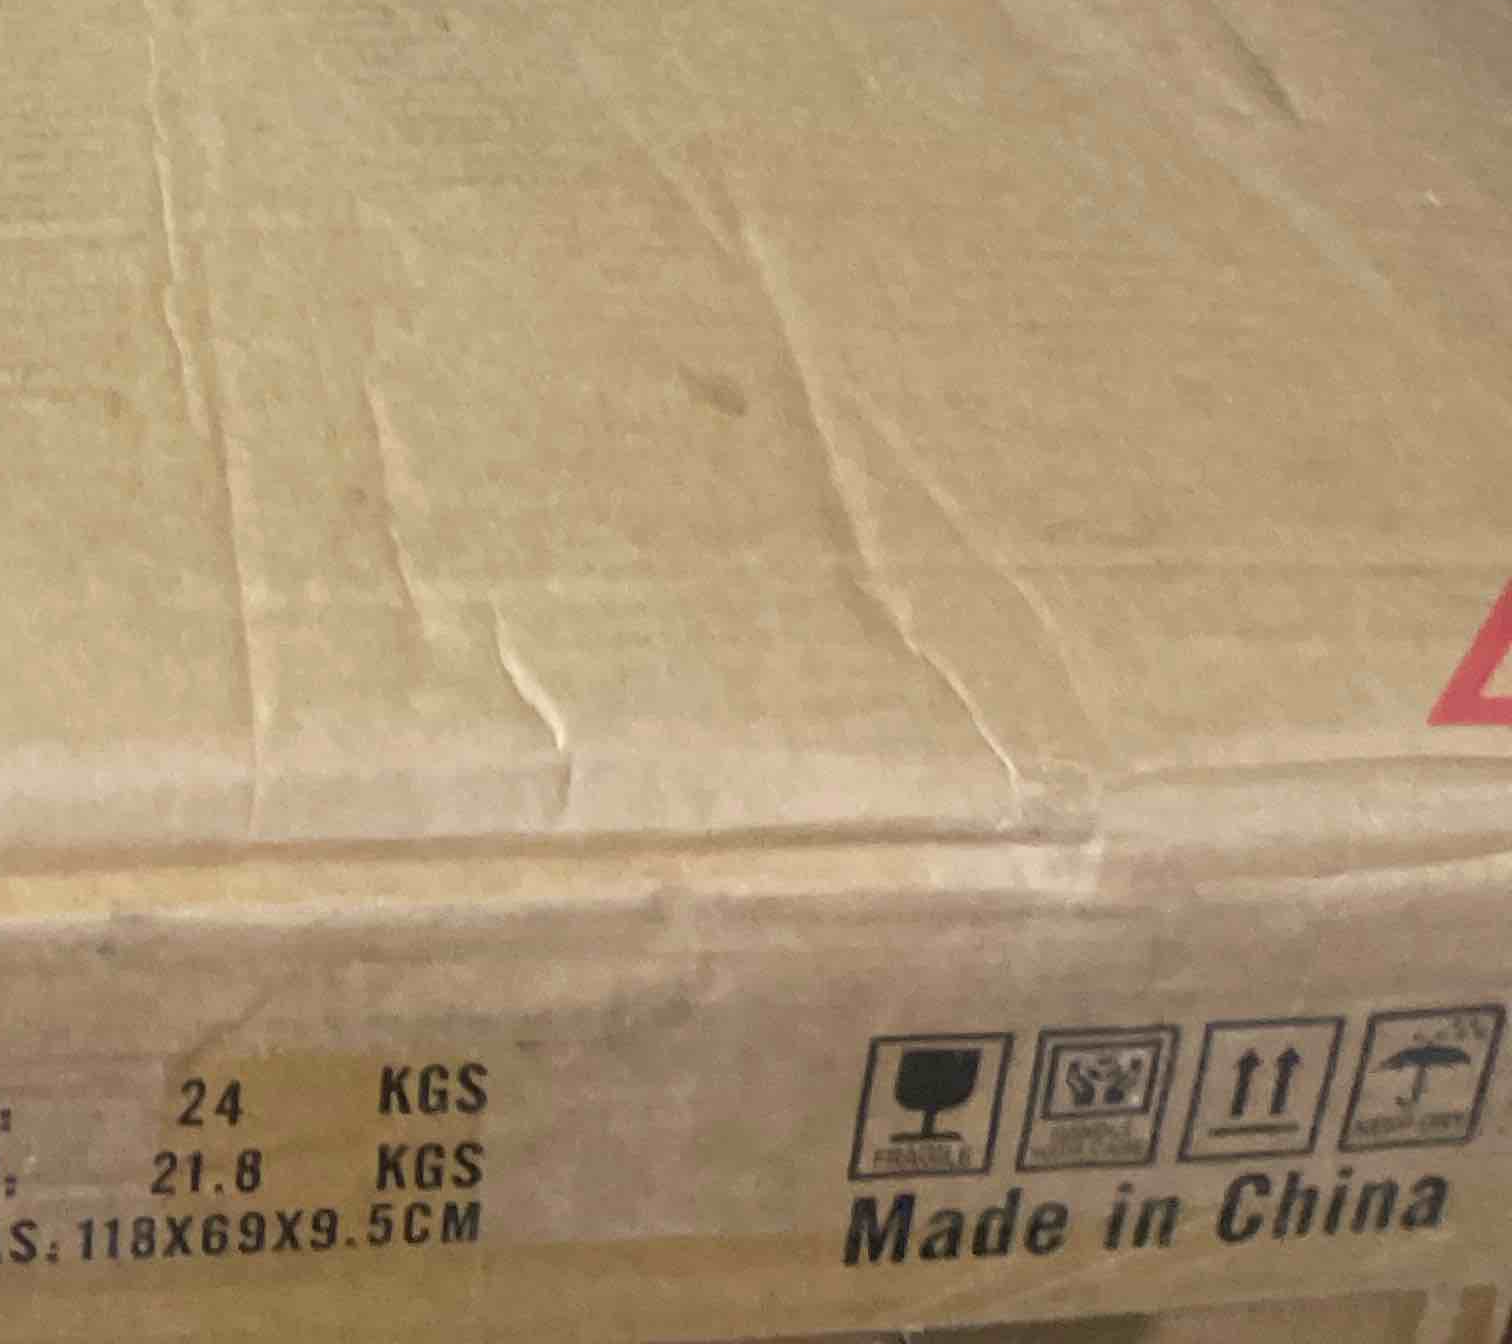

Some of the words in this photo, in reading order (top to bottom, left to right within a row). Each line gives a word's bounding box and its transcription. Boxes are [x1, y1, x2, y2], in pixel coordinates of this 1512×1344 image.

[178, 1078, 244, 1127] 24
[378, 1062, 489, 1116] KGS
[150, 1149, 263, 1196] 21.8
[376, 1142, 485, 1191] KGS
[843, 1187, 1069, 1267] Made
[1103, 1182, 1181, 1250] in
[1215, 1166, 1449, 1243] China
